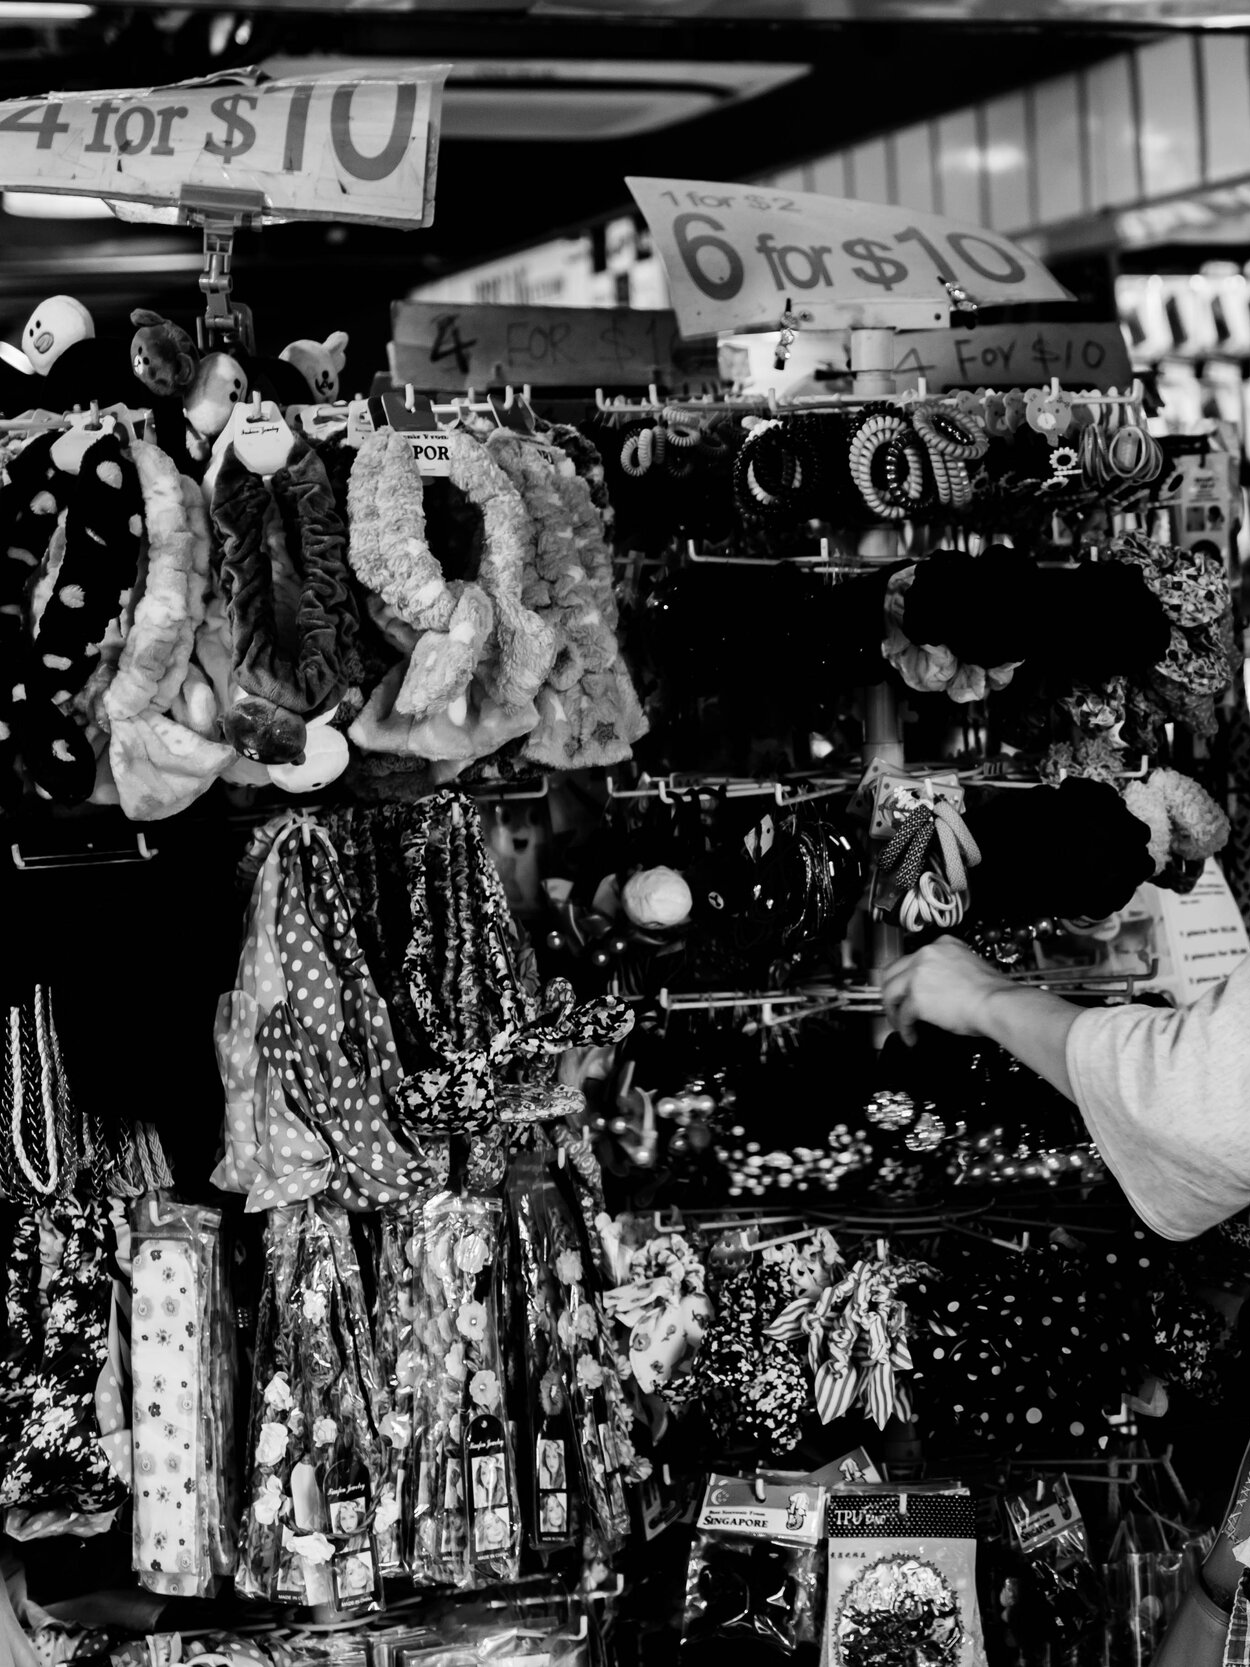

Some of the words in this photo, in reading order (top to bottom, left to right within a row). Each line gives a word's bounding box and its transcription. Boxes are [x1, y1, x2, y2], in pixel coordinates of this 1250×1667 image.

[84, 97, 188, 156] for
[204, 82, 418, 181] $10
[660, 190, 679, 207] 1
[685, 190, 737, 210] for
[743, 194, 802, 212] $2
[672, 212, 744, 301] 6
[755, 233, 834, 291] for
[841, 226, 1026, 292] $10
[429, 314, 478, 376] 4
[506, 320, 577, 368] FOR
[1031, 333, 1106, 376] $10
[703, 1515, 768, 1528] SINGAPORE
[834, 1510, 863, 1525] TPU
